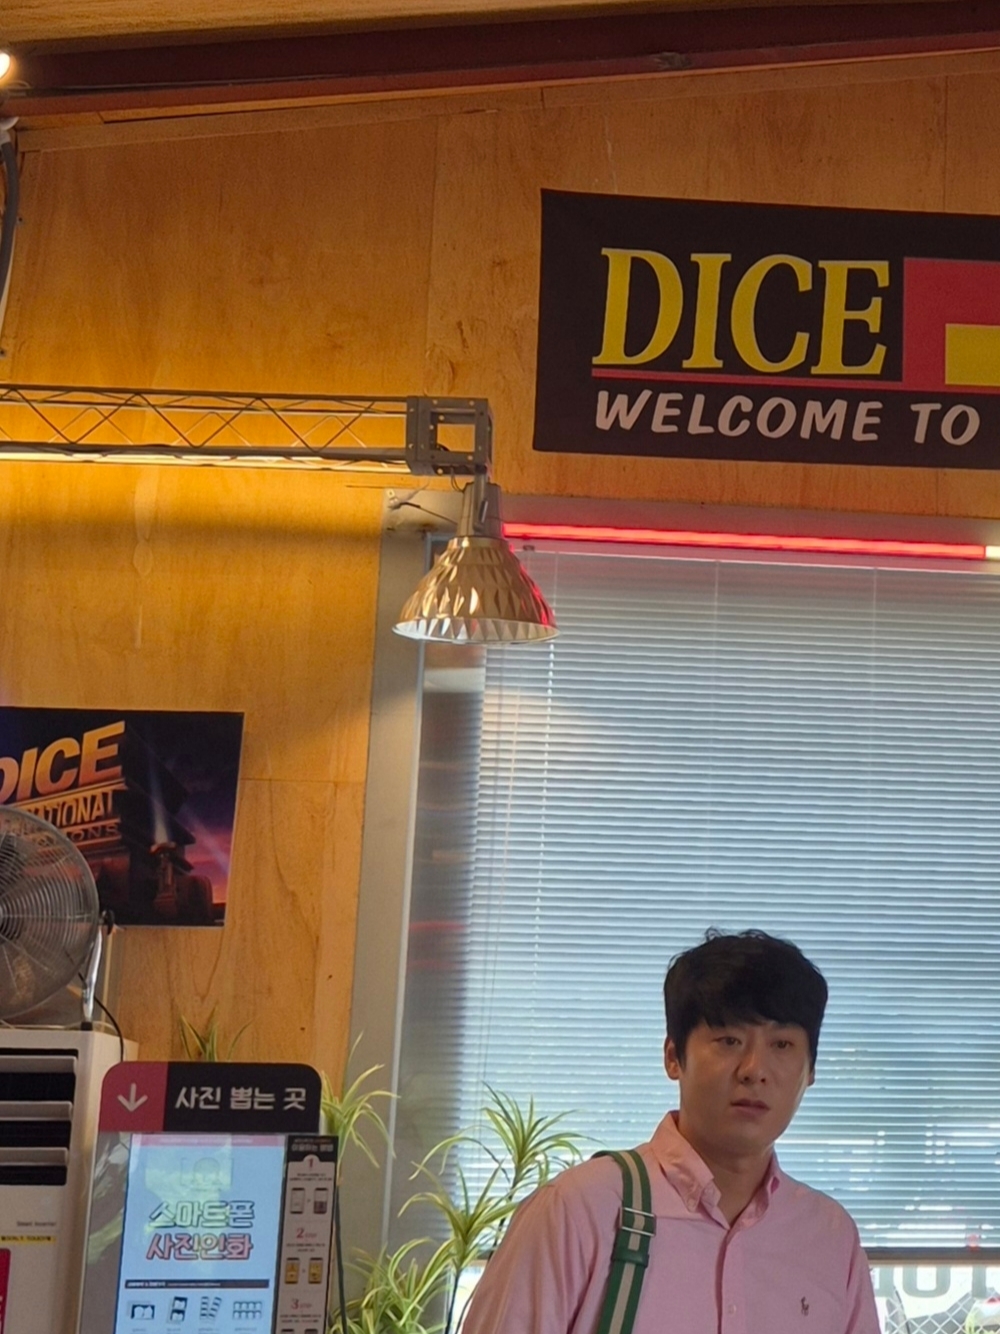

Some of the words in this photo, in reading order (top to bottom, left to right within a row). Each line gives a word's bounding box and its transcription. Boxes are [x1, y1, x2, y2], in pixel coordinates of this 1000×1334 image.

[592, 247, 890, 376] DICE
[594, 389, 884, 442] WELCOME
[910, 402, 981, 446] TO
[175, 1086, 221, 1110] 사진
[230, 1086, 276, 1111] 뽑는
[283, 1087, 307, 1111] 곳
[149, 1200, 255, 1229] 스마트폰
[146, 1233, 253, 1260] 사진인화
